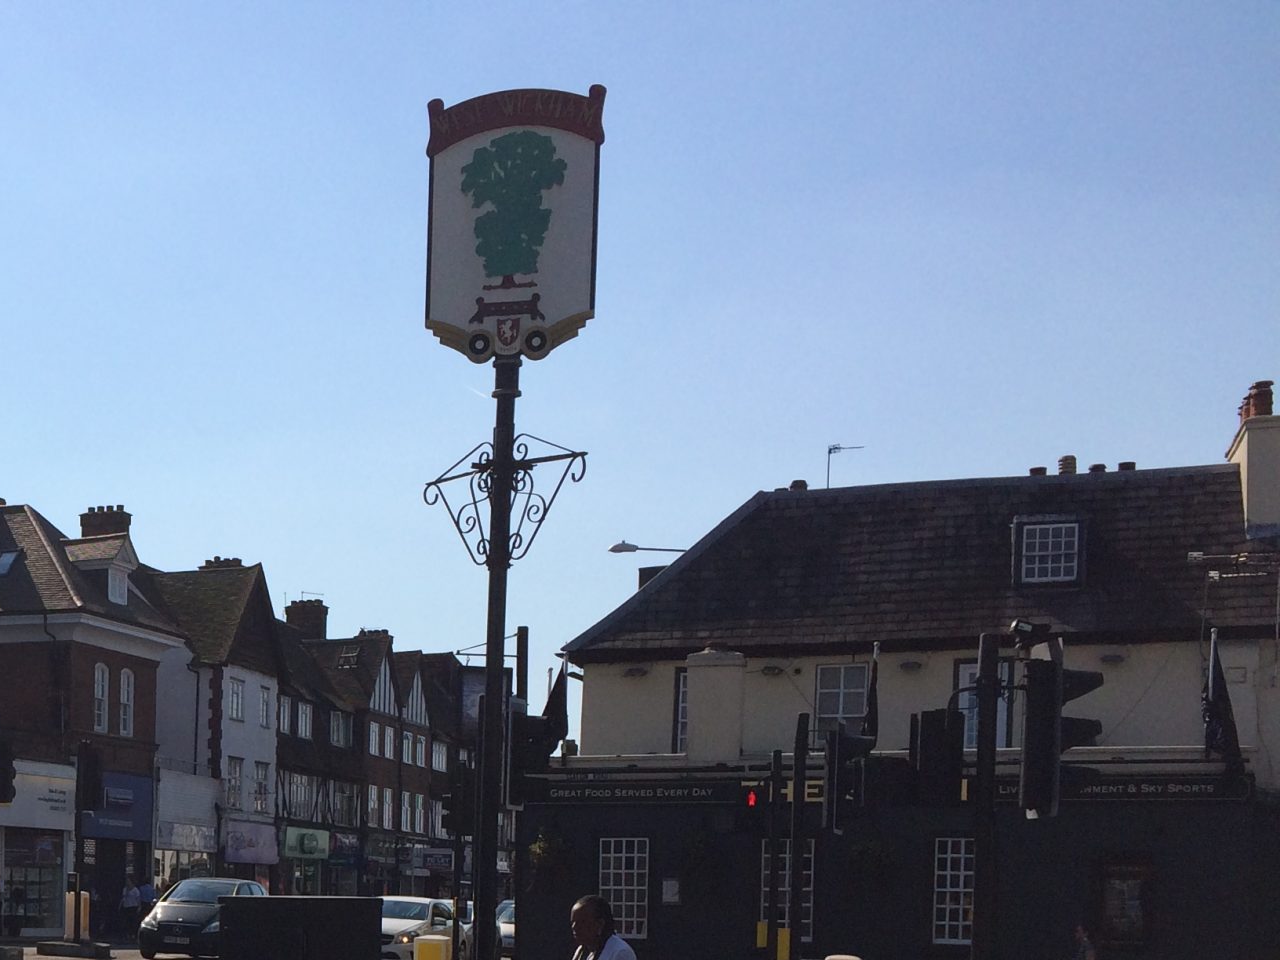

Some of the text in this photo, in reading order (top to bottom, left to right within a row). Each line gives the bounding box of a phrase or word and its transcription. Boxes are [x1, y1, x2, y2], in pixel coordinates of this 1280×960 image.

[550, 787, 714, 798] GREAT FOOD SERVED EVERY DAY
[999, 785, 1019, 794] LIV
[1127, 784, 1137, 793] &
[1141, 783, 1164, 794] SKY
[1167, 783, 1215, 794] SPORTS
